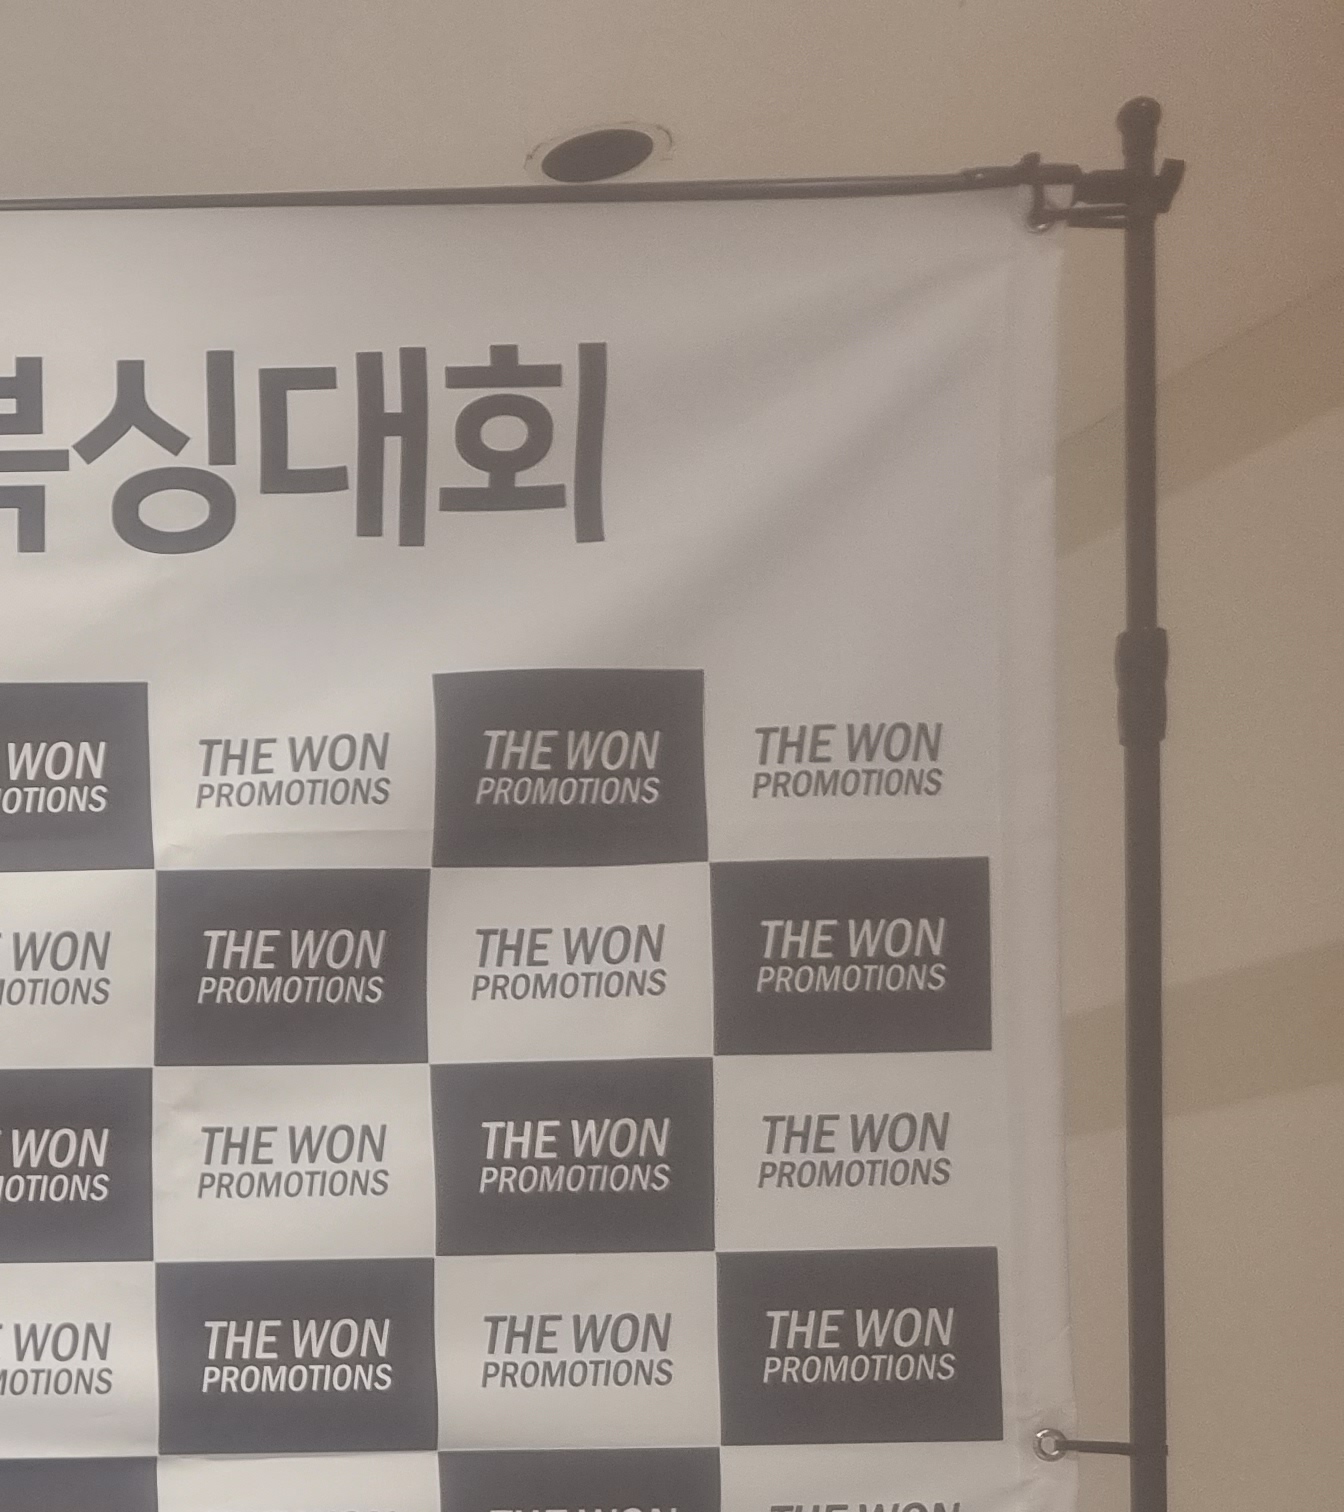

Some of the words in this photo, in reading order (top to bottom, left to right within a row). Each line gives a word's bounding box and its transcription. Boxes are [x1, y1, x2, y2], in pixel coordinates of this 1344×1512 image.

[484, 729, 559, 771] THE
[567, 730, 661, 771] WON
[475, 776, 660, 806] PROMOTIONS
[12, 930, 112, 972] WON
[475, 927, 554, 968] THE
[563, 923, 666, 966] WON
[471, 968, 667, 1001] PROMOTIONS
[11, 1127, 110, 1169] WON
[762, 1114, 841, 1155] THE
[850, 1111, 950, 1153] WON
[757, 1157, 951, 1189] PROMOTIONS
[204, 1319, 283, 1361] THE
[292, 1318, 391, 1359] WON
[765, 1309, 845, 1350] THE
[855, 1307, 955, 1348] WON
[201, 1363, 393, 1394] PROMOTIONS
[762, 1352, 956, 1384] PROMOTIONS
